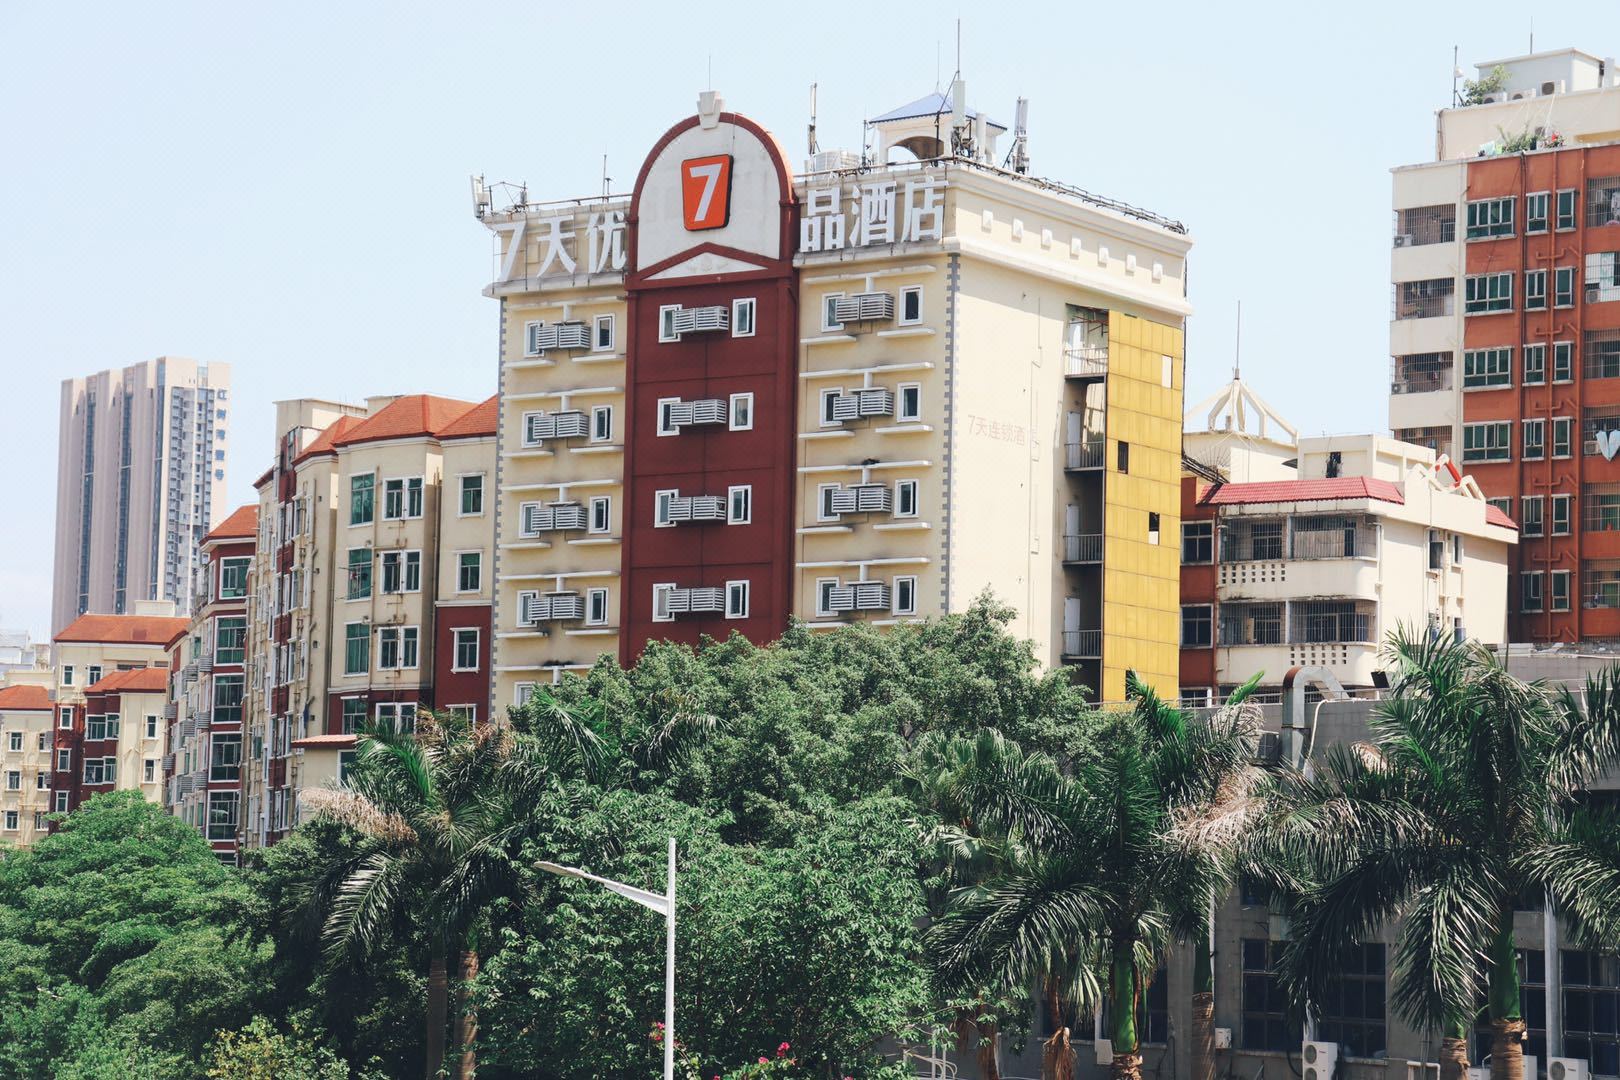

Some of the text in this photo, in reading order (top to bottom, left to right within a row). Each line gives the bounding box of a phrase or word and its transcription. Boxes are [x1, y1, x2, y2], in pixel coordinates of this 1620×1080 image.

[493, 179, 949, 282] 7天优 品酒店
[689, 162, 723, 222] 7
